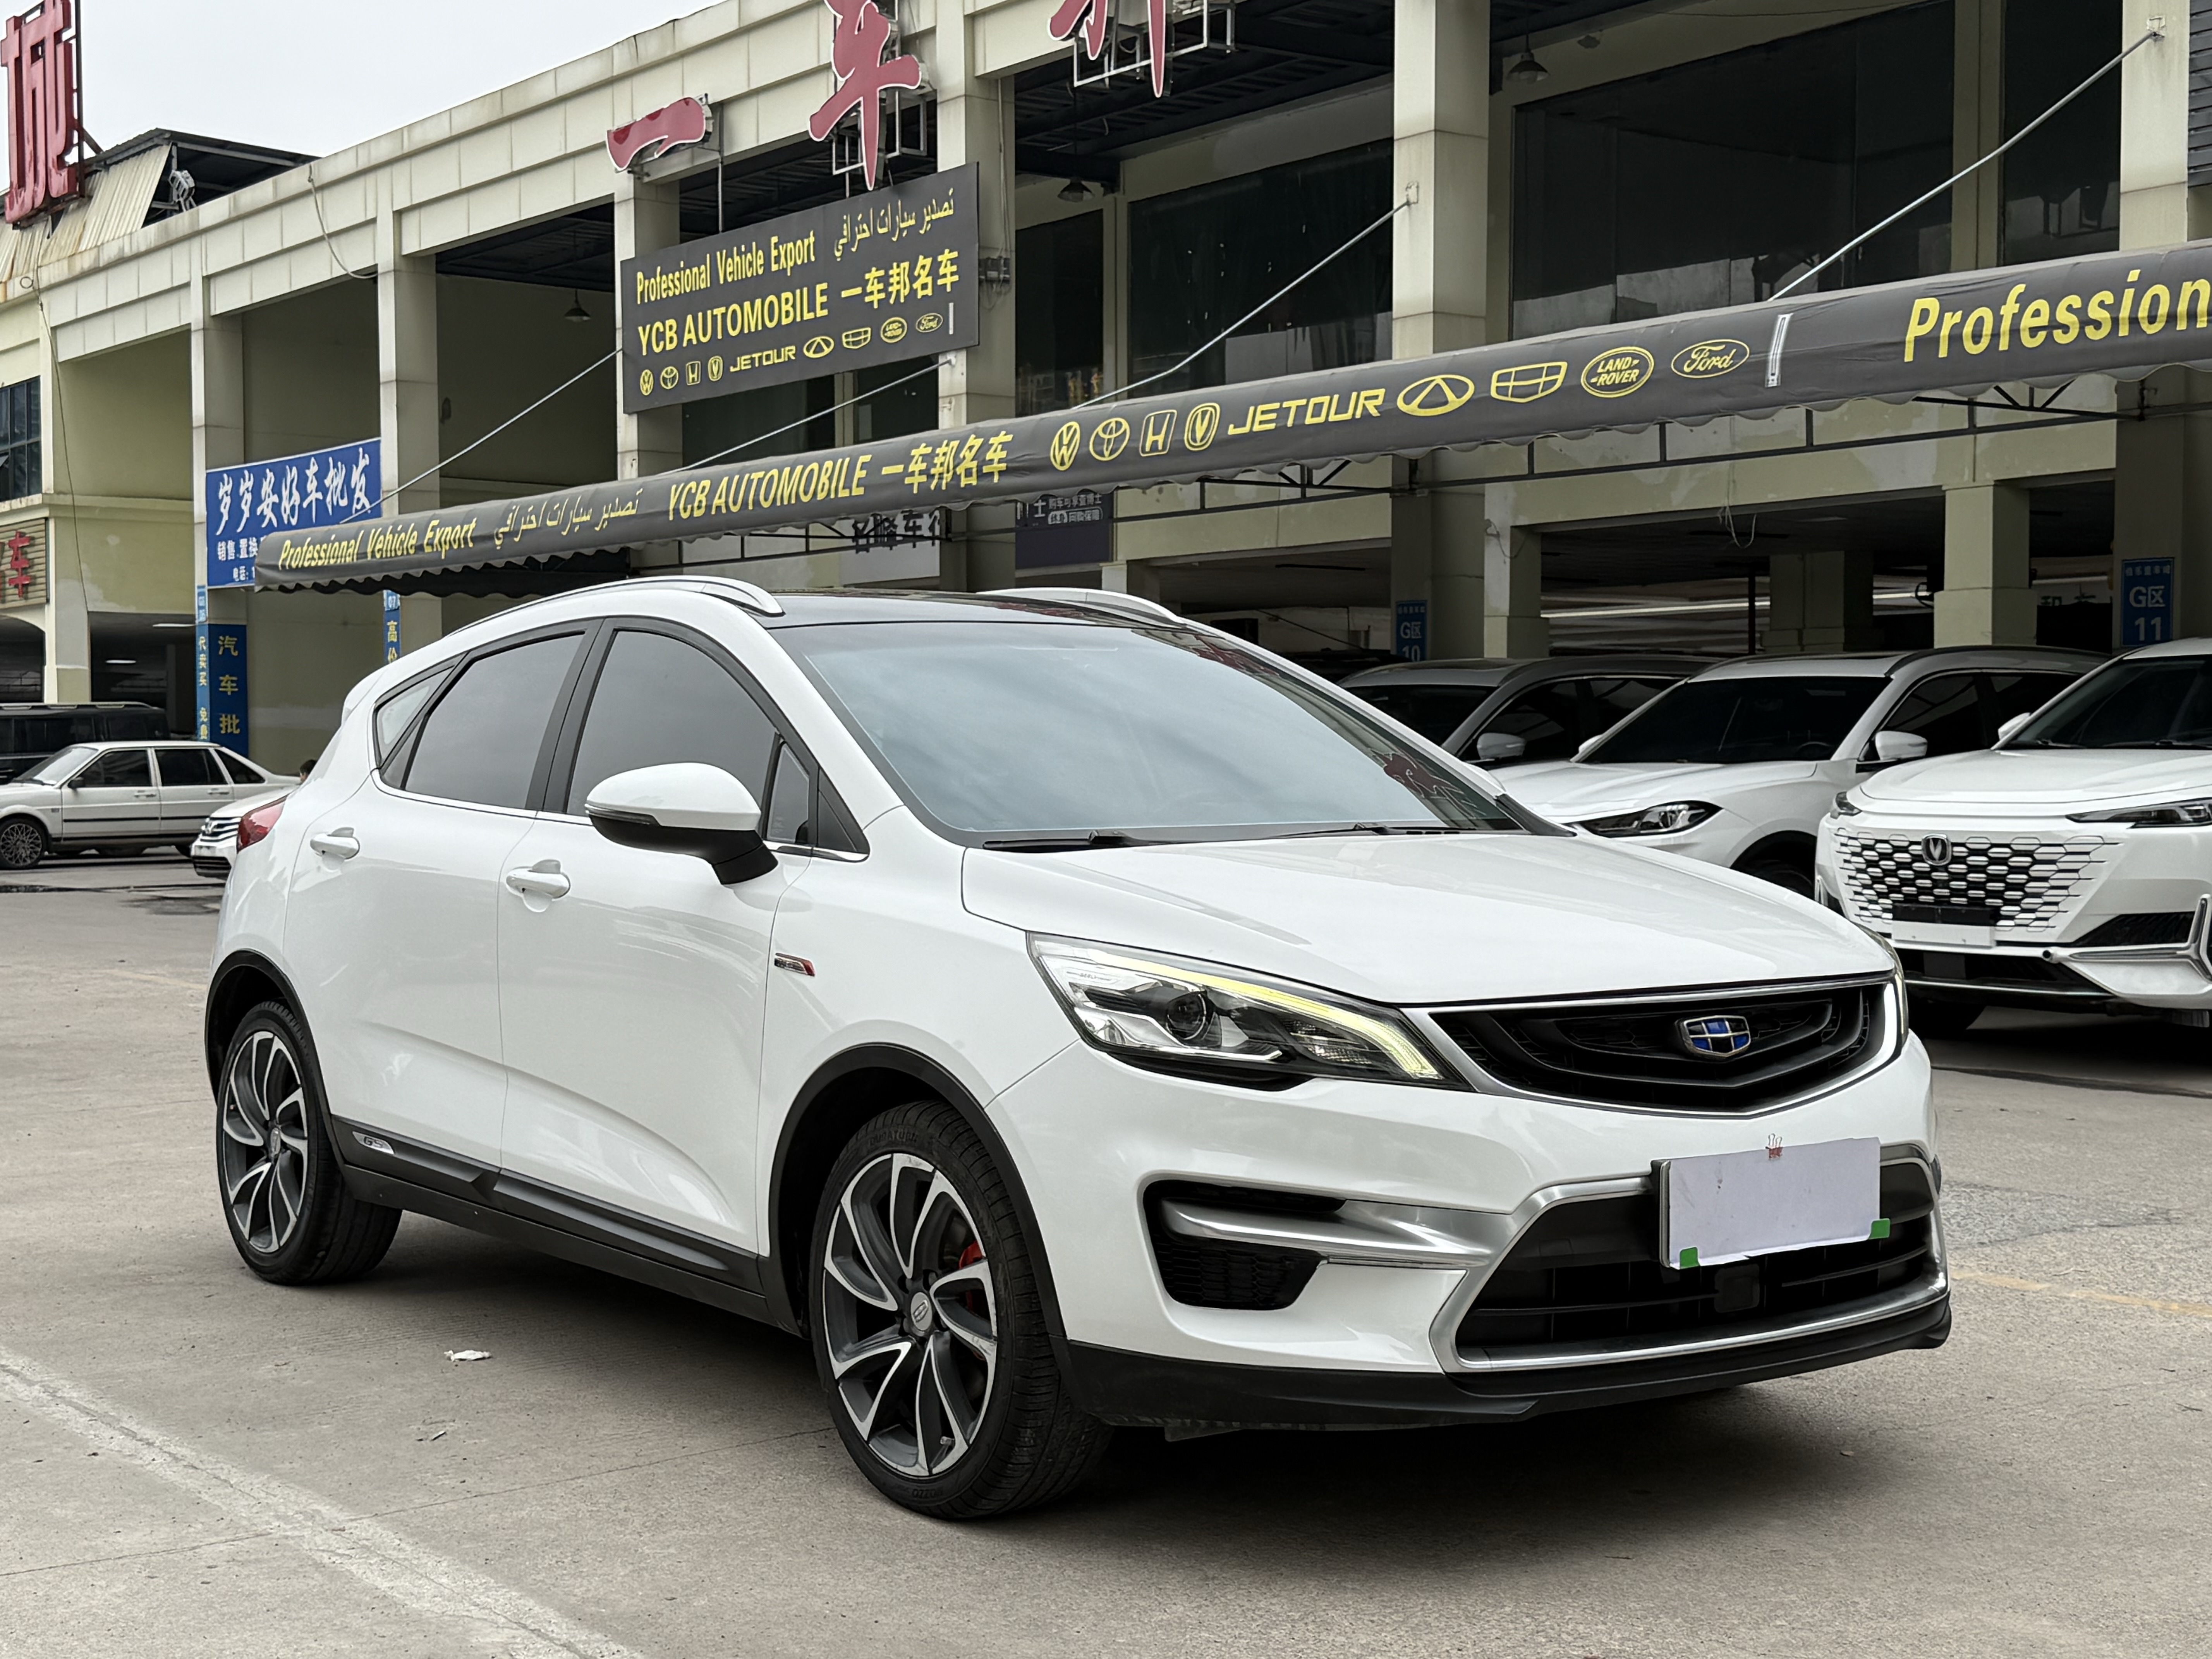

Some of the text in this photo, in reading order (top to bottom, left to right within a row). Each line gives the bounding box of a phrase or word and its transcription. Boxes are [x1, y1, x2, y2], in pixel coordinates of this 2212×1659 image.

[637, 231, 815, 305] Professional Vehicle Export
[638, 249, 959, 356] YCB AUTOMOBILE 一车邦名车
[1904, 269, 2212, 362] Profession
[730, 345, 796, 373] JETOUR
[1228, 388, 1386, 435] JETOUR
[1683, 345, 1737, 373] Ford
[669, 431, 1013, 520] YCB AUTOMOBILE 一车邦名车
[278, 517, 477, 570] Professional Vehicle Export
[2129, 585, 2166, 608] G区
[1402, 644, 1421, 661] 10
[2135, 617, 2162, 641] 11
[363, 1136, 383, 1149] GS
